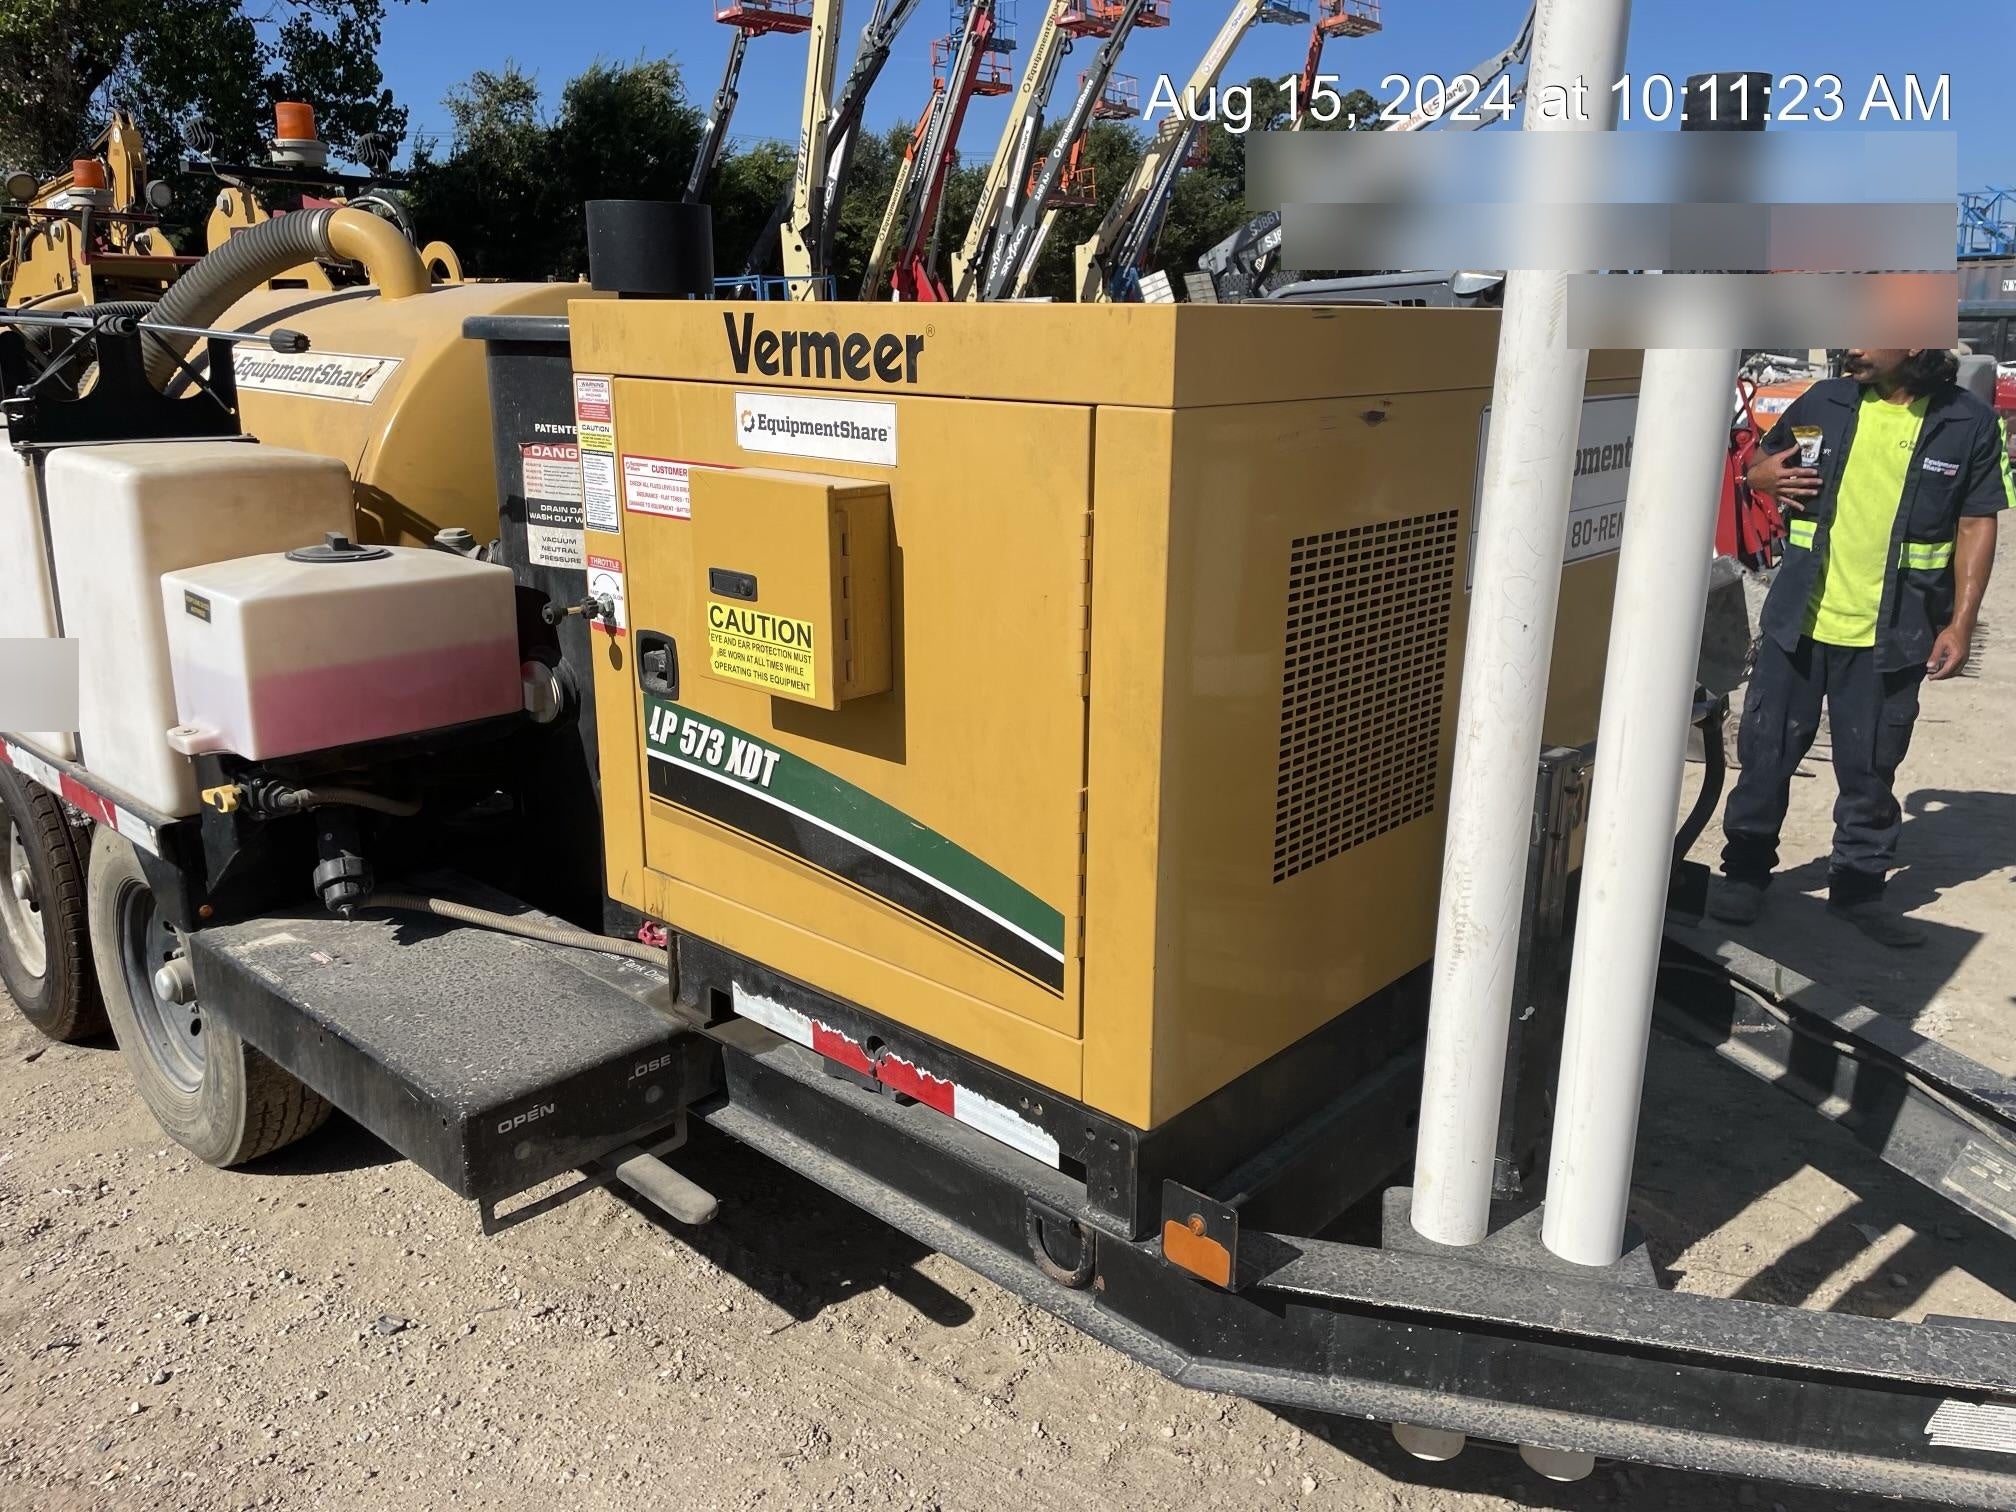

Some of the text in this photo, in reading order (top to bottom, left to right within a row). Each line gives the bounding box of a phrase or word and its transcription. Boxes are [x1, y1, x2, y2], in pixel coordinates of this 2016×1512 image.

[990, 233, 1005, 280] SKYJACK
[1000, 223, 1028, 276] SKYJACK
[723, 312, 925, 384] Vermeer
[235, 356, 371, 389] EquipmentShare
[582, 424, 610, 433] CAUTION
[757, 413, 888, 442] EquipmentShare
[651, 464, 688, 477] CUSTOMER
[529, 512, 553, 521] WASH
[555, 515, 573, 523] OUT
[540, 504, 568, 513] DRAIN
[541, 536, 577, 545] VACUUM
[541, 545, 579, 554] NEUTRAL
[540, 554, 582, 564] PRESSURE
[590, 556, 620, 569] THROTTLE
[709, 604, 812, 649] CAUTION
[711, 633, 812, 665] EYE AND EAR PROTECTION MUST
[719, 648, 804, 676] BE WORN AT ALL TIMES WHILE
[714, 660, 810, 692] OPERATING THIS EQUIPMENT
[649, 705, 781, 788] LP 573 XDT
[622, 959, 647, 973] Tank
[497, 1102, 555, 1134] OPEN
